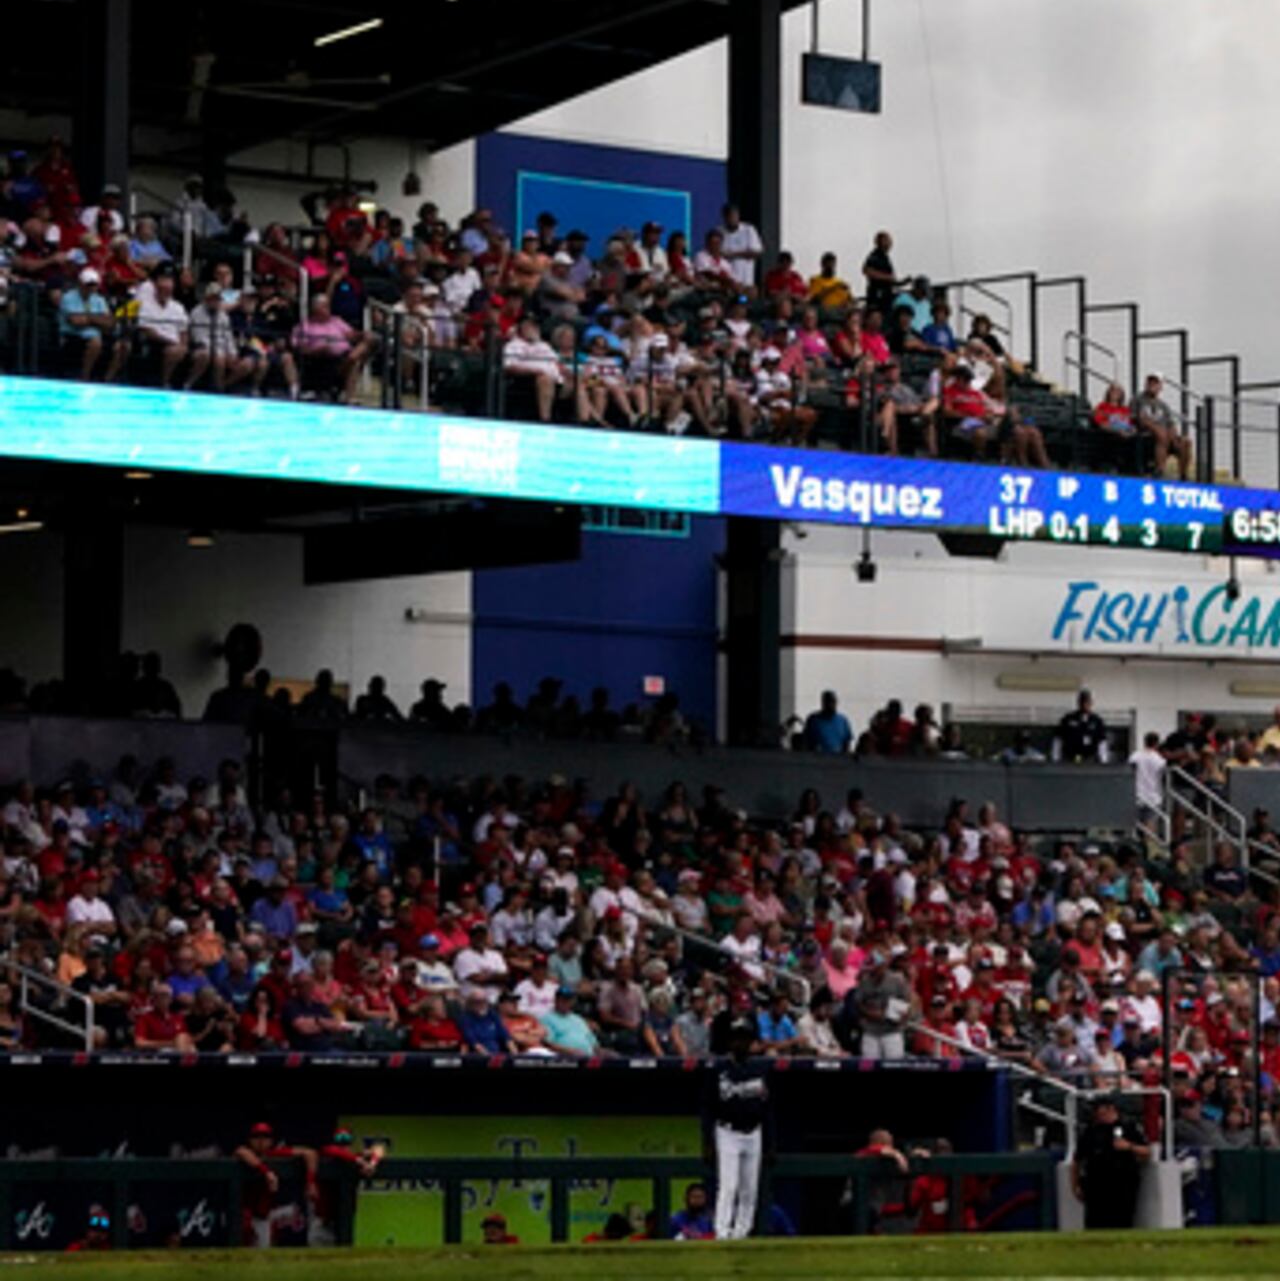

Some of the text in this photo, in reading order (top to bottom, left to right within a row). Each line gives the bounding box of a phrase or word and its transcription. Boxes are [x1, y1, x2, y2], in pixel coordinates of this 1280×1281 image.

[770, 465, 943, 524] Vasquez
[1000, 474, 1033, 504] 37
[1162, 486, 1224, 510] TOTAL
[989, 506, 1205, 550] LHP 0.1 4 3 7
